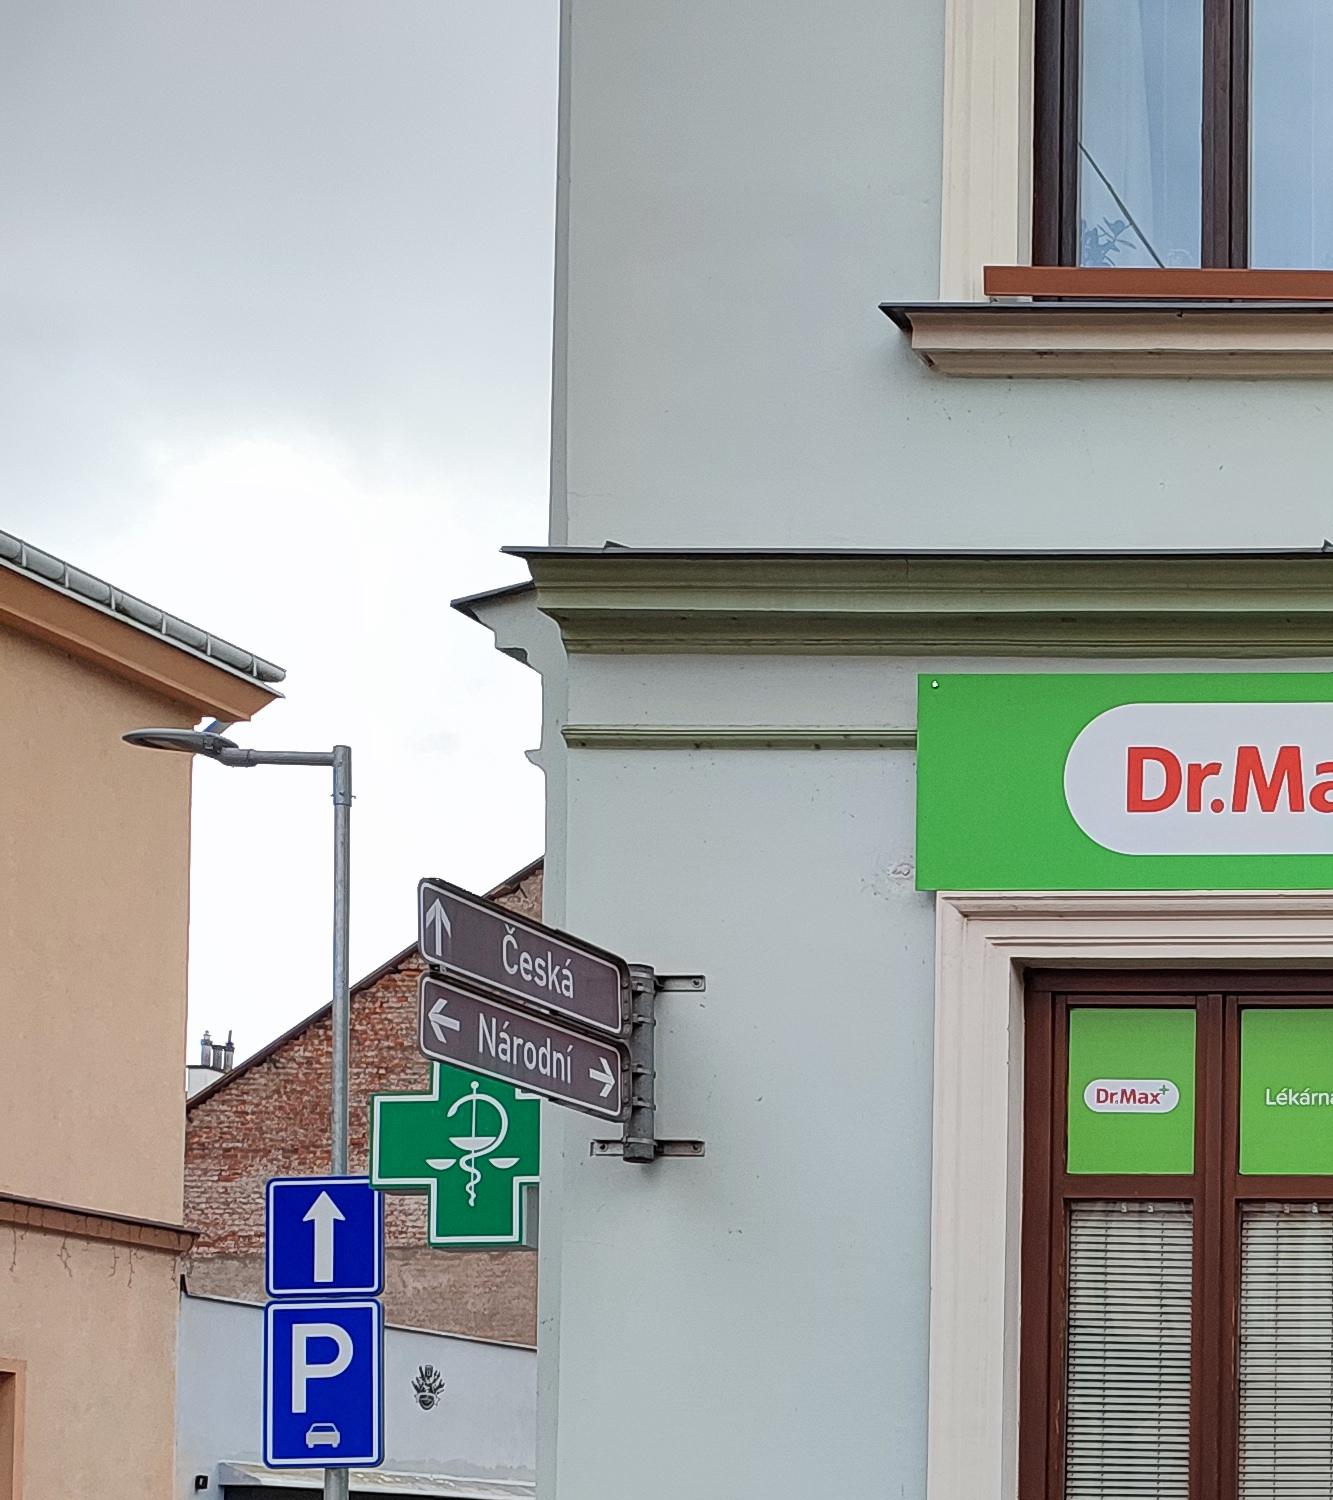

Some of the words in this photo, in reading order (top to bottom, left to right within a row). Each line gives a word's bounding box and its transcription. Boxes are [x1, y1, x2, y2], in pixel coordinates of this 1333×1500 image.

[502, 924, 574, 999] Česká
[478, 1012, 574, 1084] Národní
[292, 1323, 354, 1413] P
